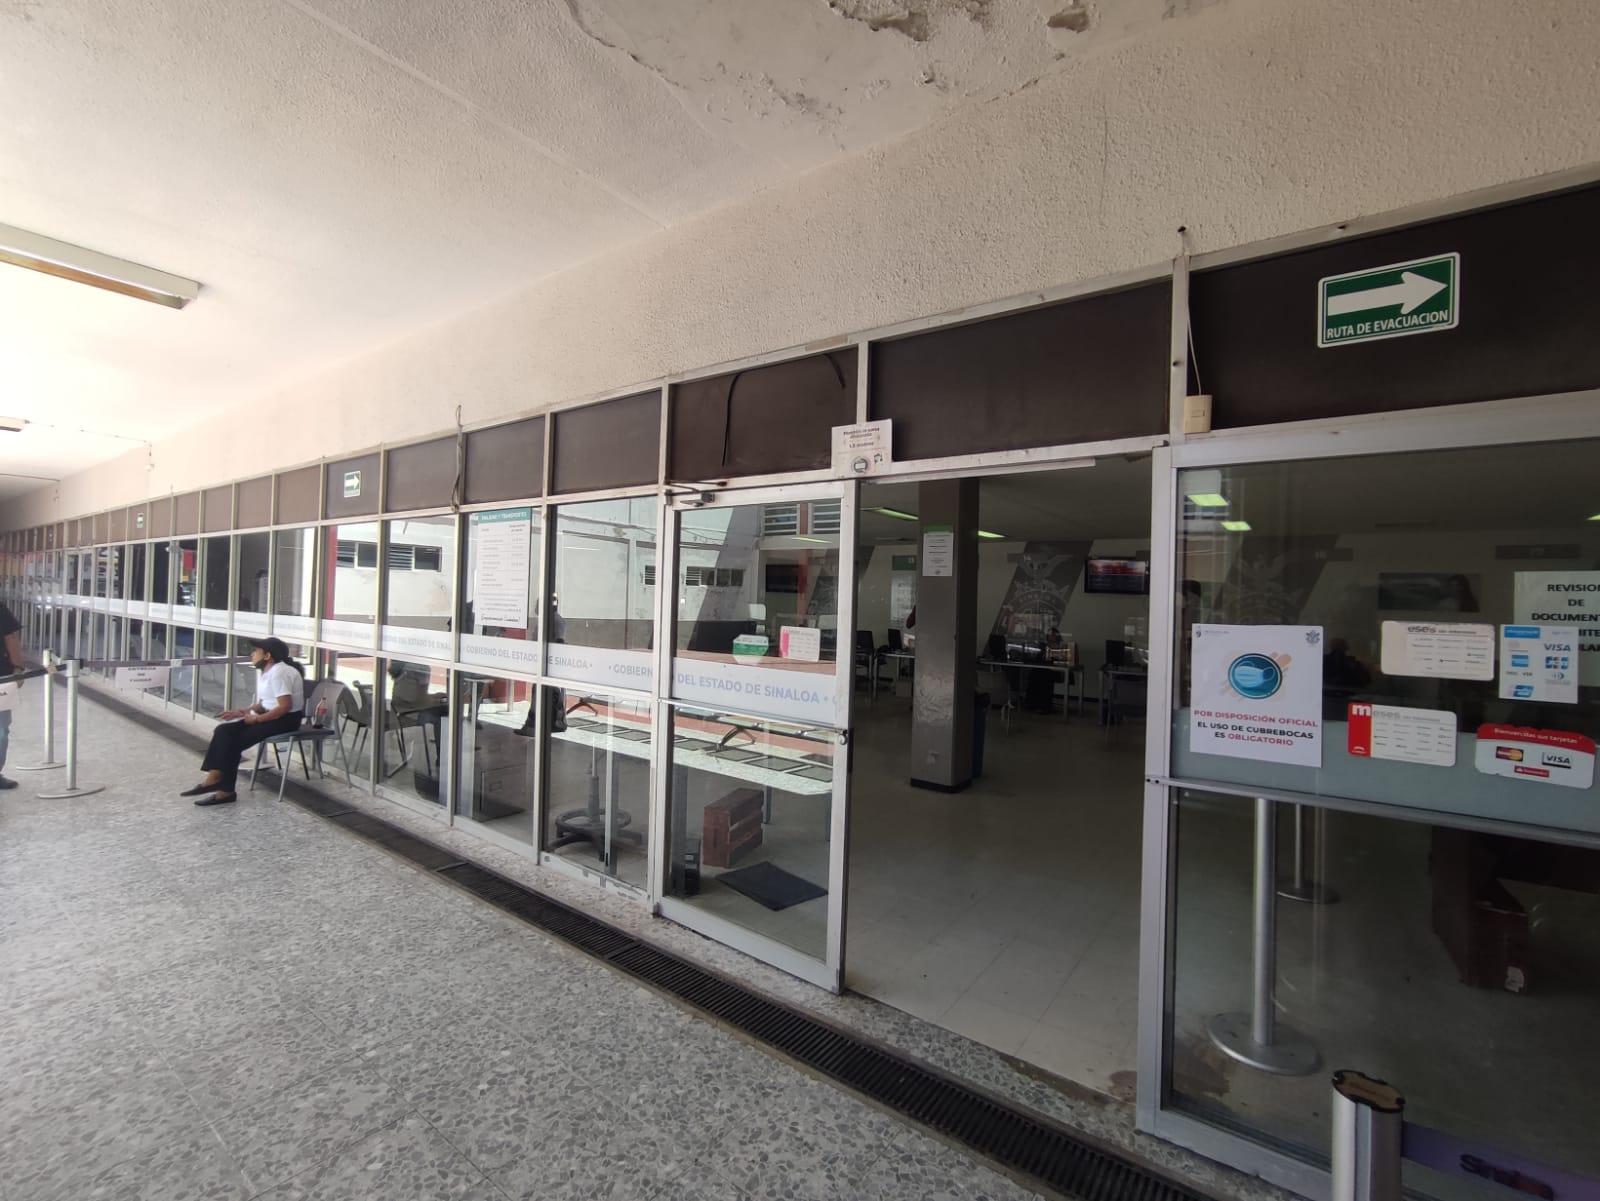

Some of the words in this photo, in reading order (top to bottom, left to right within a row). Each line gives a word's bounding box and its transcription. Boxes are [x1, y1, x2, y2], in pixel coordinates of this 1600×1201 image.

[1326, 327, 1354, 339] RUTA
[1357, 322, 1371, 334] DE
[1373, 310, 1449, 332] EVACUACION
[1567, 599, 1585, 607] DE
[1543, 643, 1571, 651] VISA
[466, 645, 498, 657] GOBIERNO
[498, 649, 511, 659] DEL
[511, 650, 538, 663] ESTADO
[554, 656, 589, 669] SINALOA
[613, 663, 653, 678] GOBIERN
[677, 672, 697, 687] DEL
[699, 676, 743, 693] ESTADO
[745, 684, 761, 695] DE
[764, 687, 820, 705] SINALOA
[1194, 709, 1213, 718] POR
[1215, 710, 1276, 723] DISPOSICIÓN
[1278, 718, 1318, 728] OFICIAL
[1197, 721, 1207, 729] EL
[1210, 722, 1229, 730] USO
[1231, 724, 1244, 732] DE
[1246, 726, 1314, 740] CUBREBOCAS
[1214, 731, 1226, 739] ES
[1227, 733, 1294, 746] OBLIGATORIO
[1546, 754, 1571, 764] VISA
